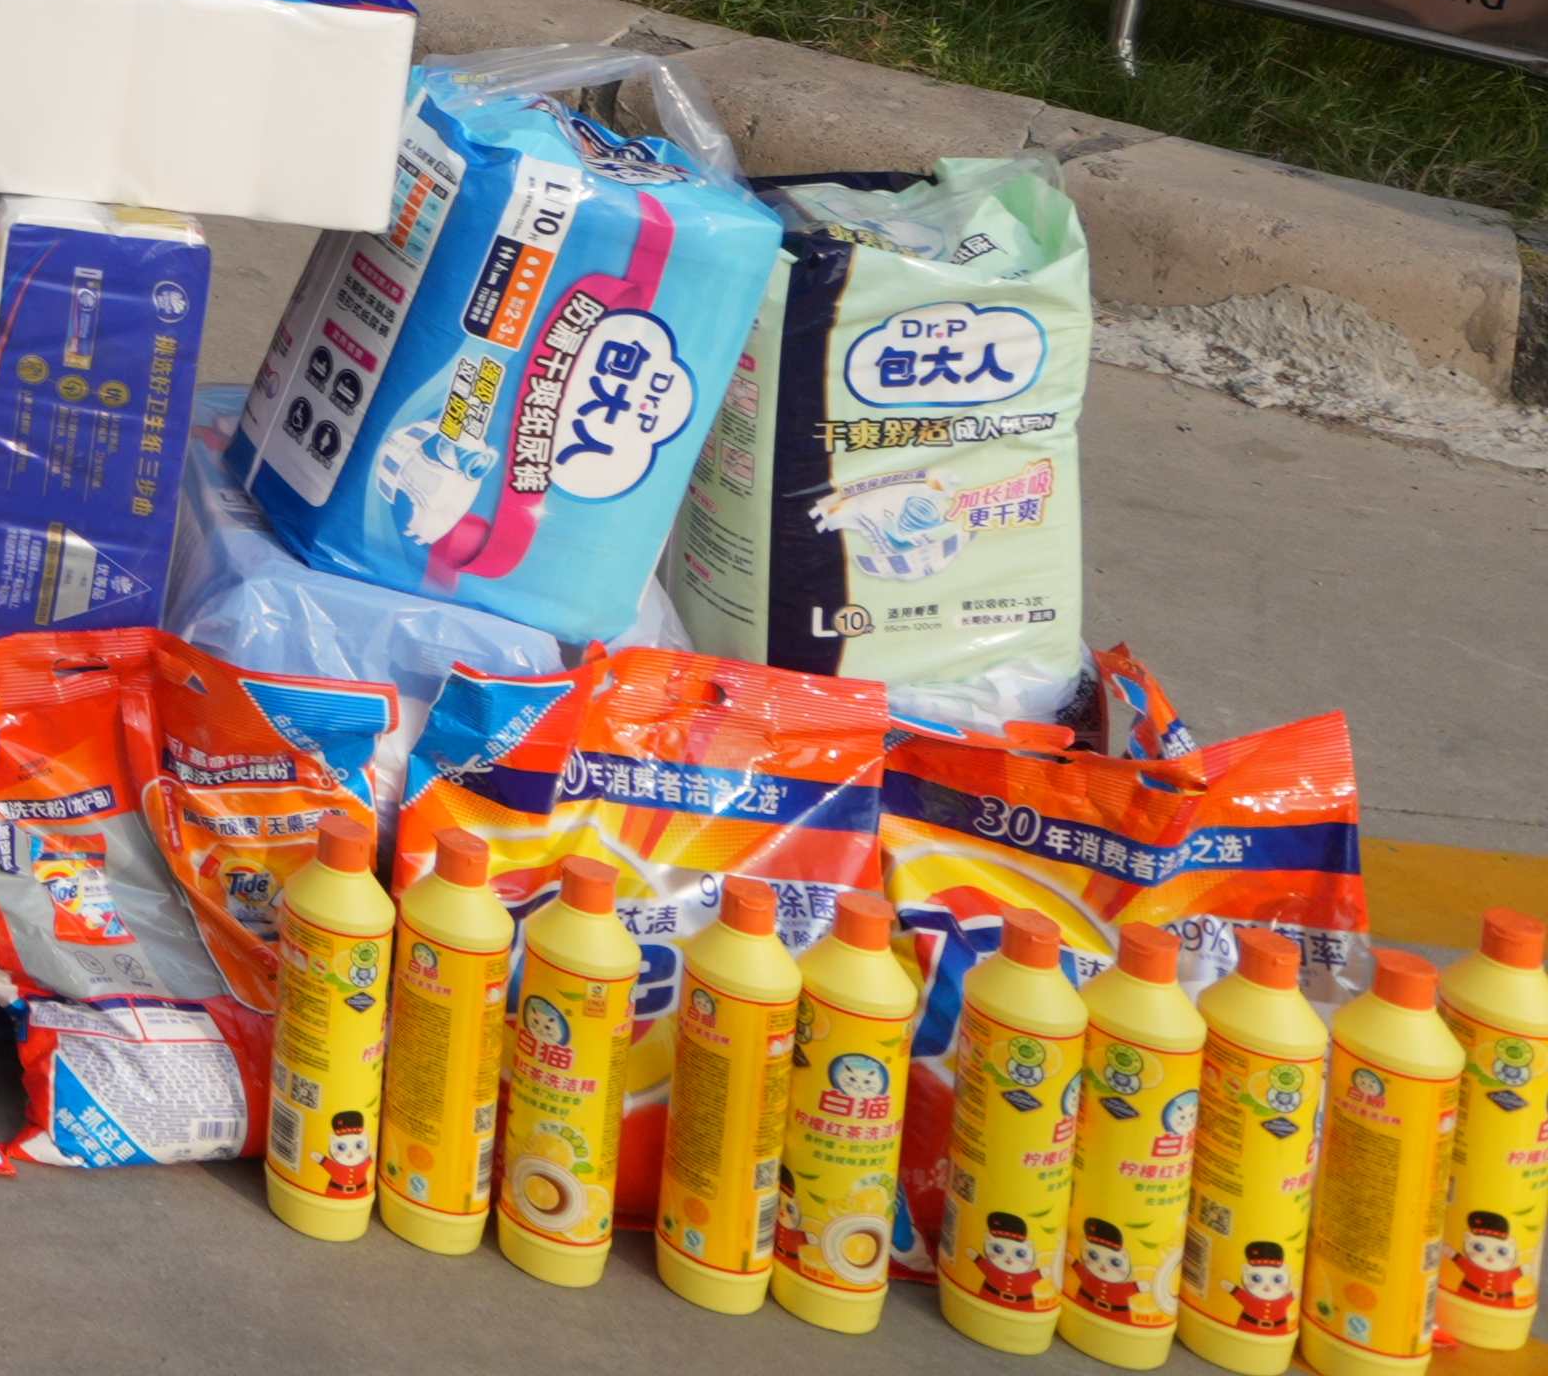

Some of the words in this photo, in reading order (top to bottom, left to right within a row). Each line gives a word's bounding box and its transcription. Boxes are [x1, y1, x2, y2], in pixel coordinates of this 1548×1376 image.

[901, 319, 968, 338] Dr.P
[875, 343, 1014, 387] 包大人
[513, 290, 606, 495] 防漏干爽纸尿裤
[556, 340, 652, 465] 包大人
[640, 372, 675, 433] Dr.P
[813, 417, 953, 452] 干爽舒适
[950, 461, 1053, 518] 加长速吸
[968, 498, 1042, 529] 更干爽
[812, 606, 836, 637] L
[225, 873, 268, 894] Tide
[517, 1031, 573, 1070] 白猫
[819, 1089, 891, 1120] 白猫
